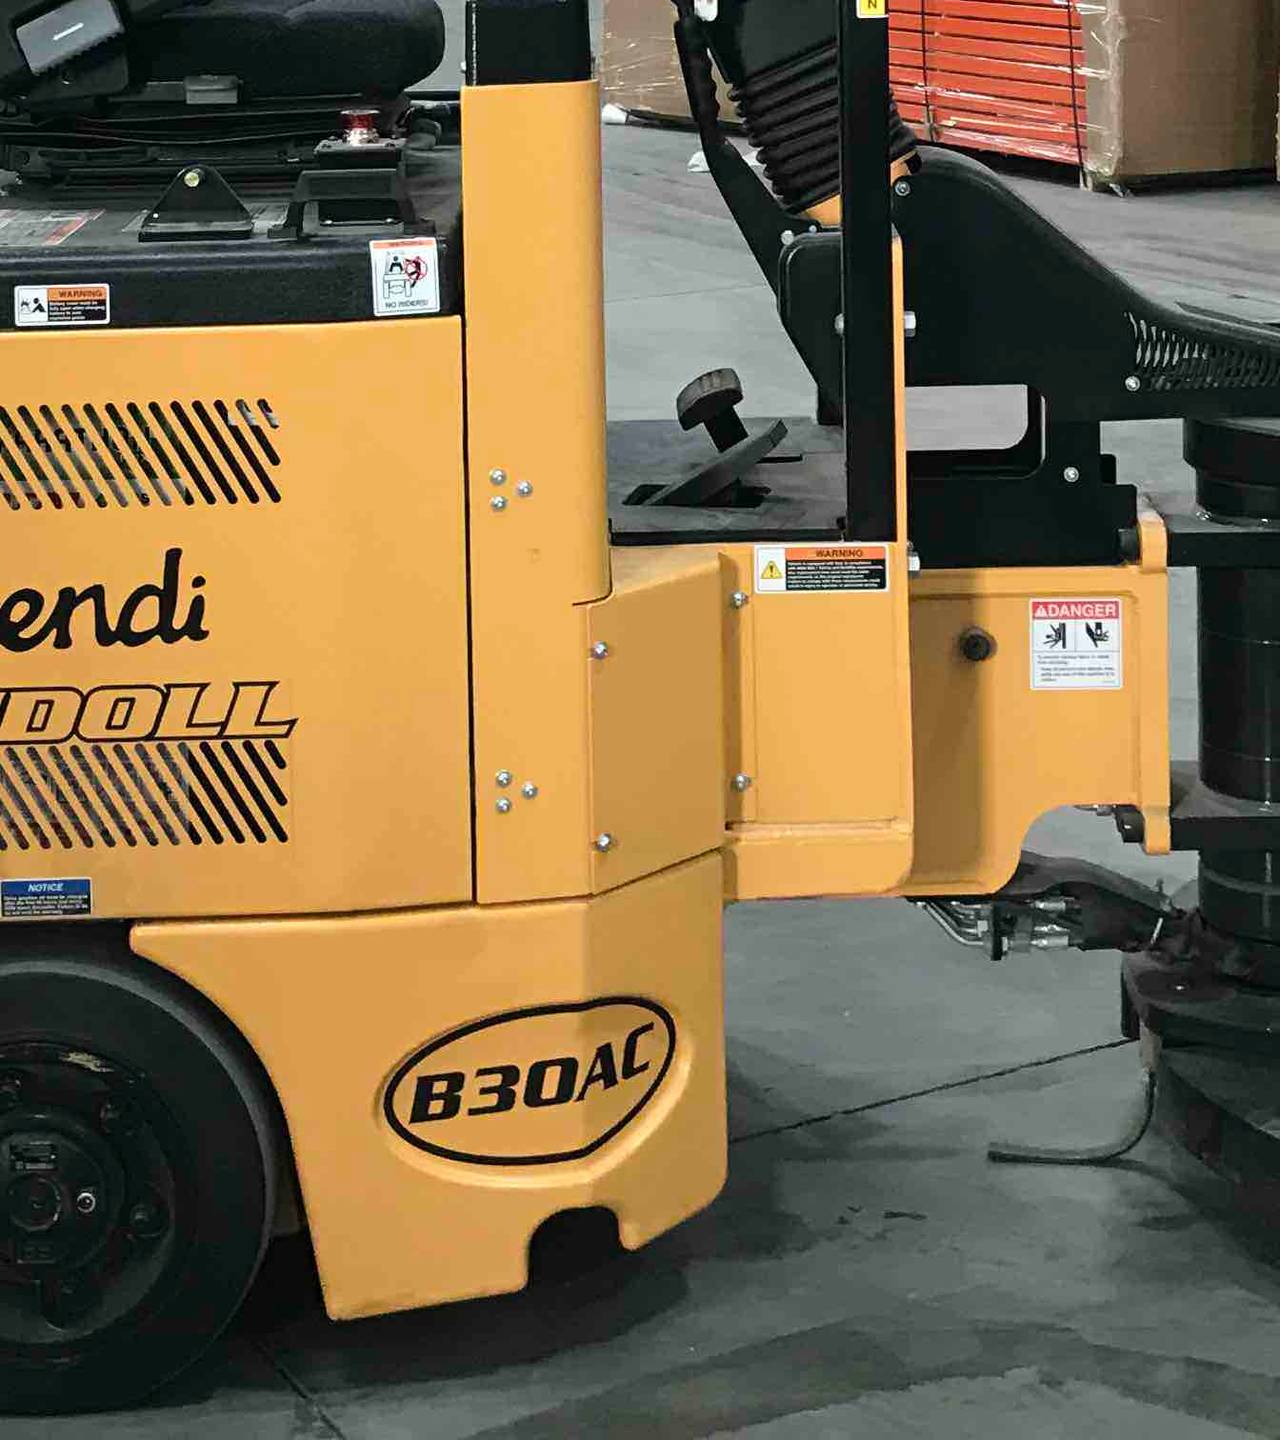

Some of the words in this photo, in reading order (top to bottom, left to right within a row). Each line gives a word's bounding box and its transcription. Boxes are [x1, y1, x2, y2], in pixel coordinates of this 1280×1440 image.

[59, 289, 103, 299] WARNING
[815, 548, 864, 559] WARNING
[1047, 603, 1117, 618] DANGER
[27, 882, 64, 893] NOTICE
[408, 1021, 655, 1125] B30AC
